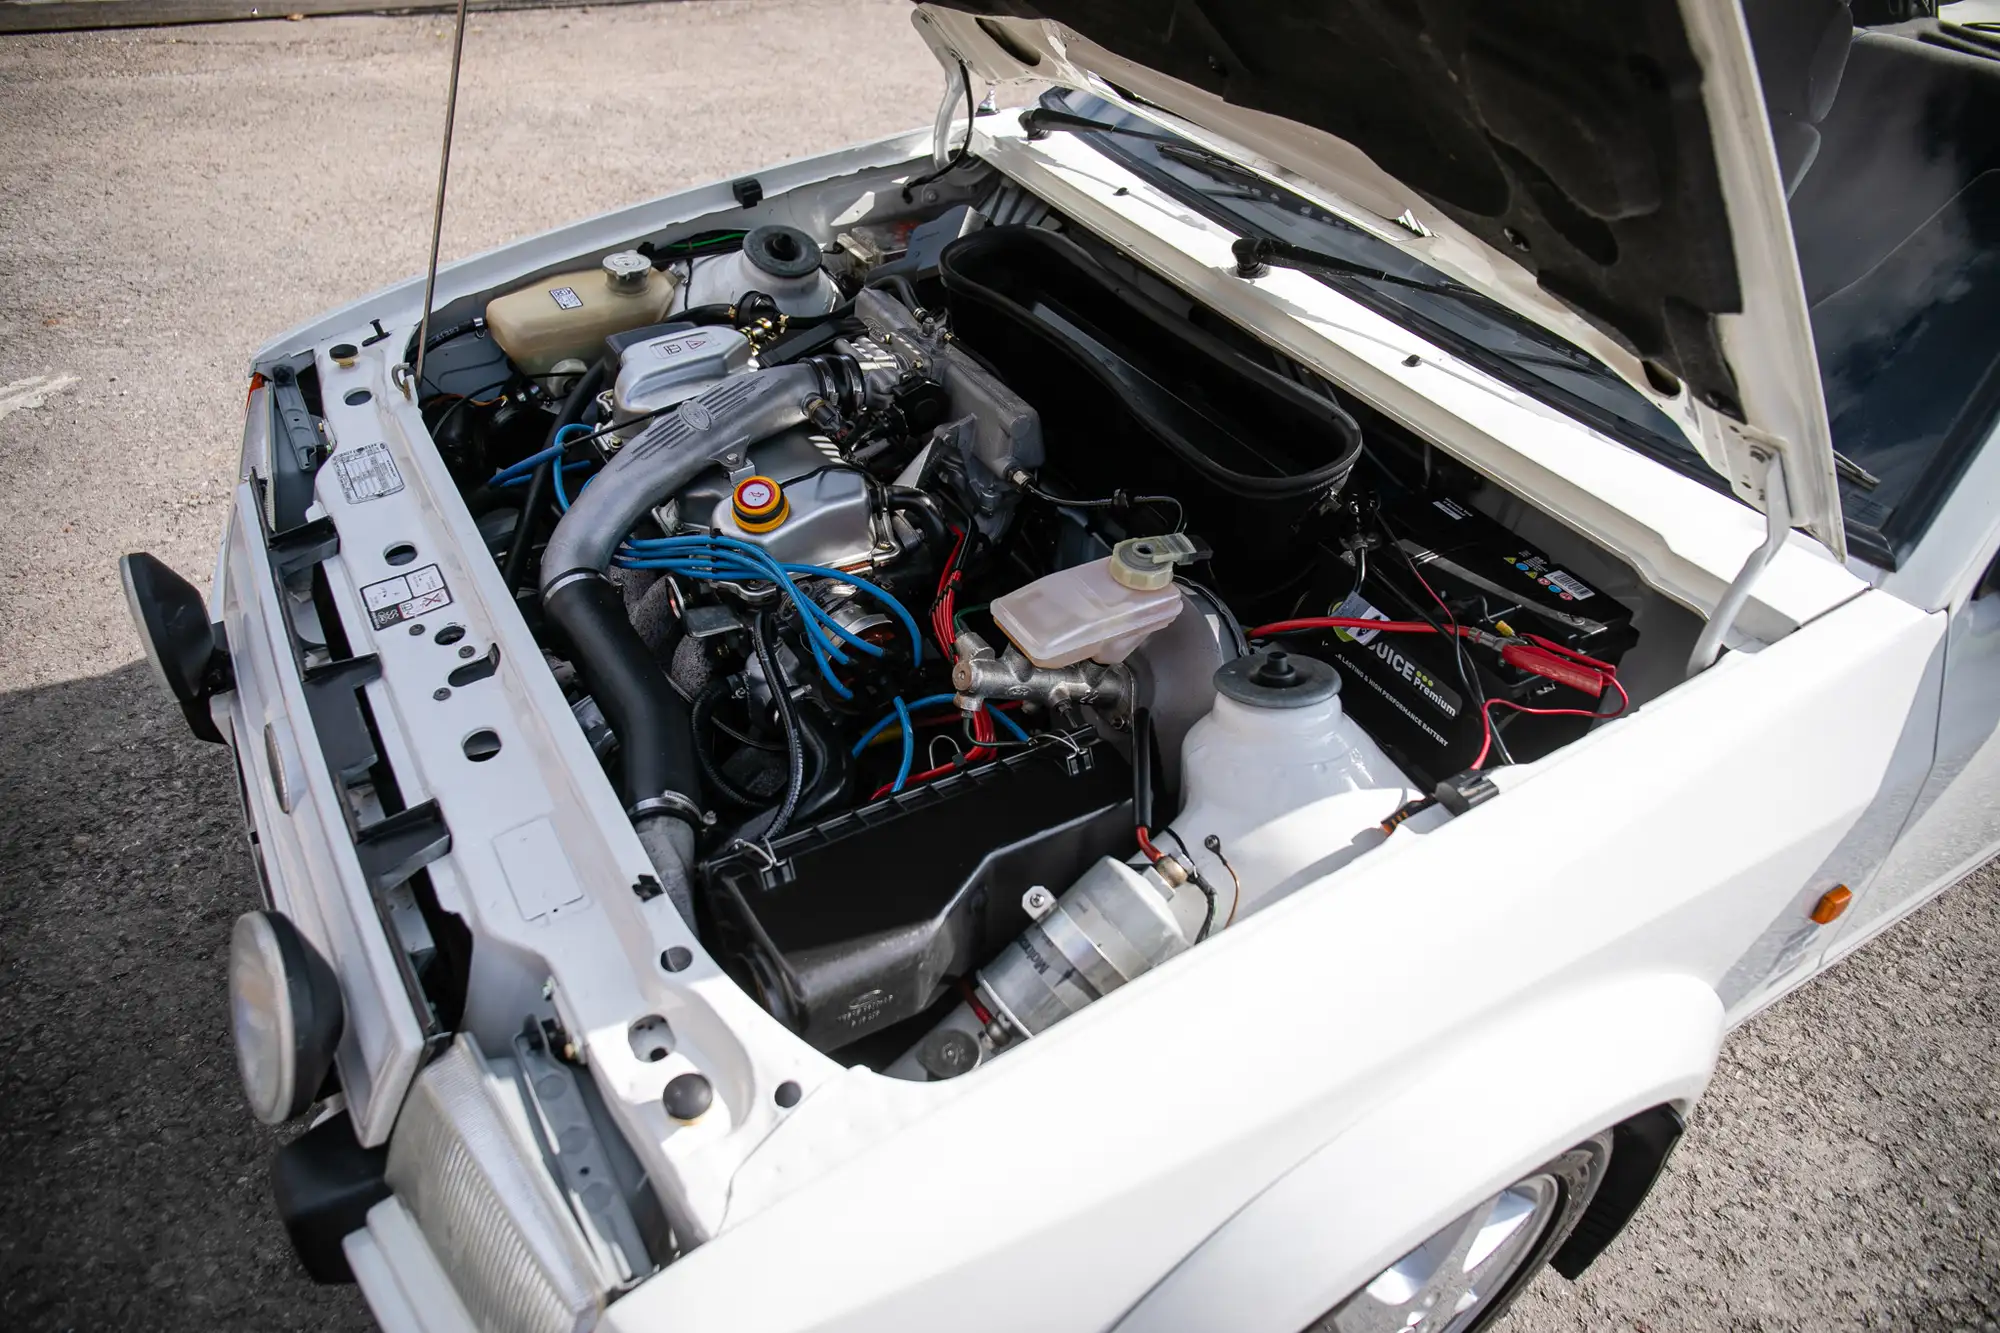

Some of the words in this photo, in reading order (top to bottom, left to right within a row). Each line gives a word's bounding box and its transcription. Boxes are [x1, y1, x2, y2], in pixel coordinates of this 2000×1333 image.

[1381, 689, 1423, 727] PERFORMANCE
[1422, 722, 1448, 747] BATTERY
[1413, 676, 1456, 717] Premium
